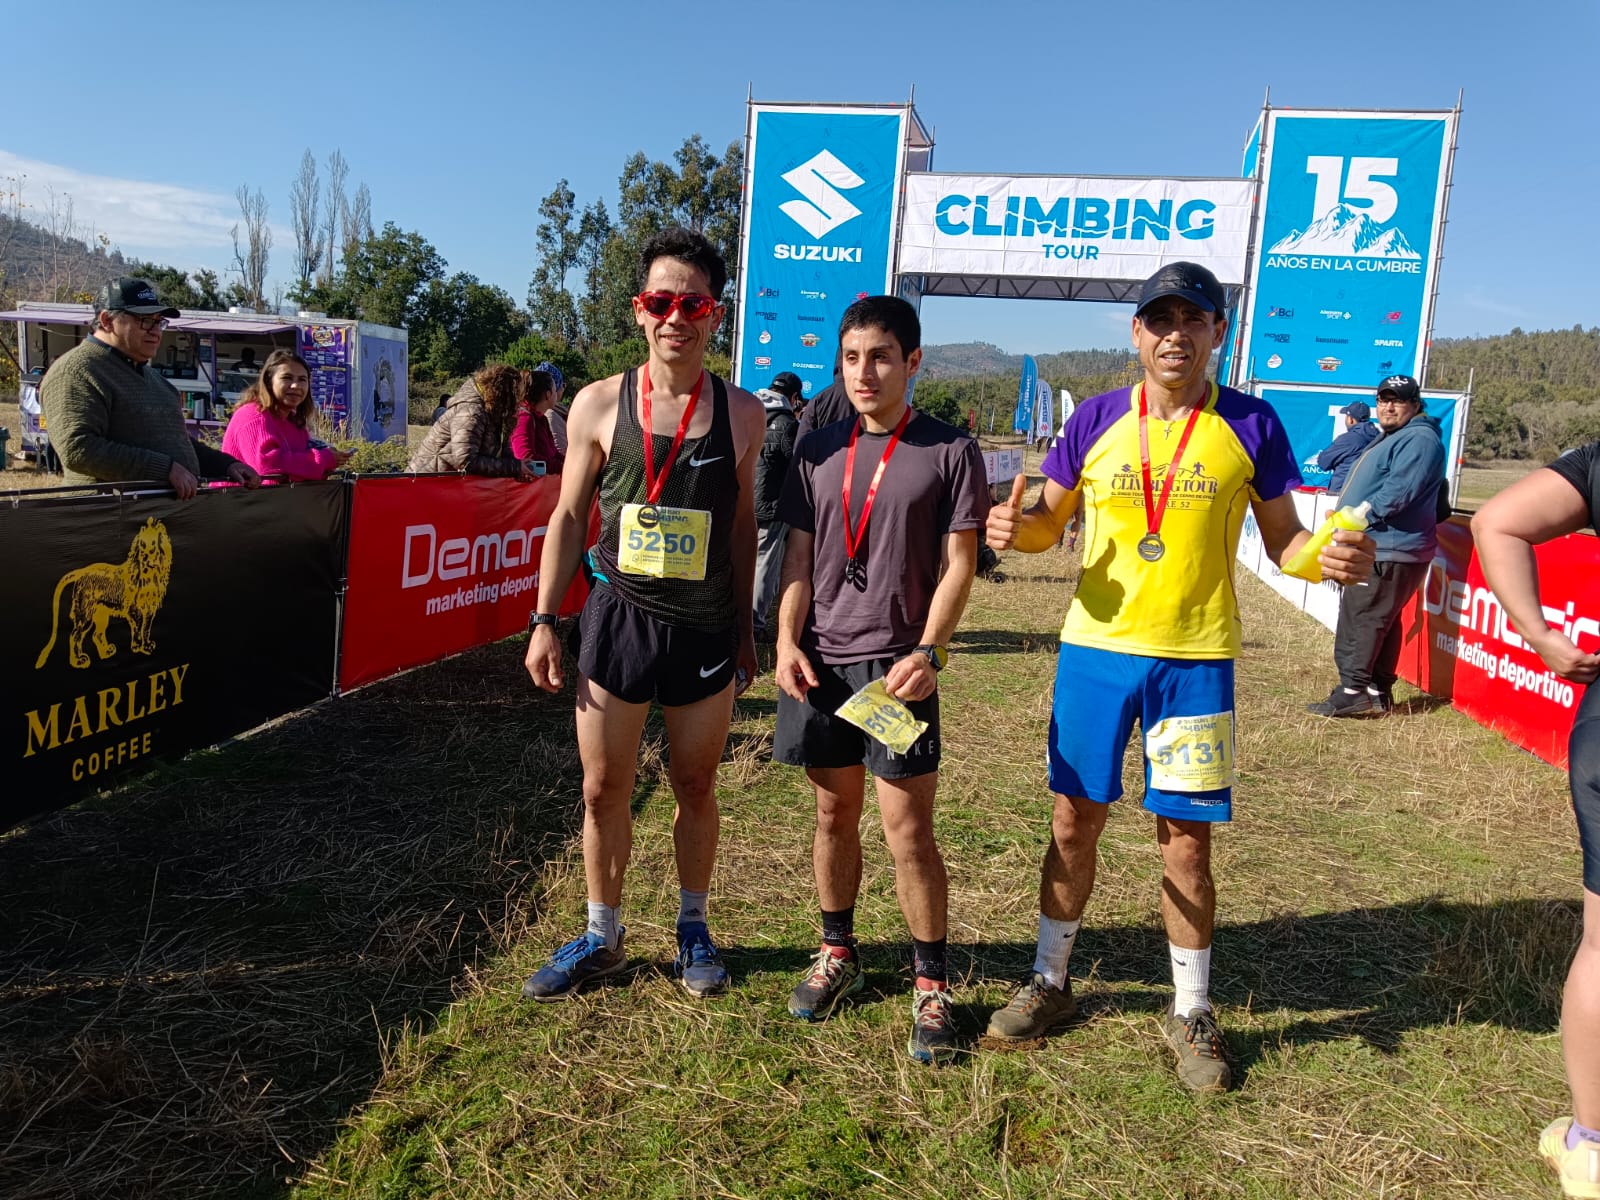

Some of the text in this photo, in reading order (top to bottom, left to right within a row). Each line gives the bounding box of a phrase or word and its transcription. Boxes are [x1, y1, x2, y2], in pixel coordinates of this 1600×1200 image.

[1306, 155, 1399, 225] 15
[935, 194, 1217, 241] CLIMBING
[773, 244, 863, 263] SUZUKI
[1042, 244, 1099, 260] TOUR
[1265, 254, 1422, 274] AÑOS EN LA CUMBRE
[766, 288, 780, 298] Bci
[1278, 307, 1295, 318] Bci
[1373, 339, 1404, 348] SPARTA
[1181, 479, 1218, 494] TOUR
[1133, 499, 1177, 508] CURE
[627, 529, 696, 555] 5250
[402, 523, 549, 590] Demar
[426, 569, 540, 616] marketing deport
[1436, 631, 1575, 709] marketing deportivo
[23, 663, 190, 759] MARLEY
[72, 731, 152, 782] COFFEE
[1157, 739, 1226, 766] 5131
